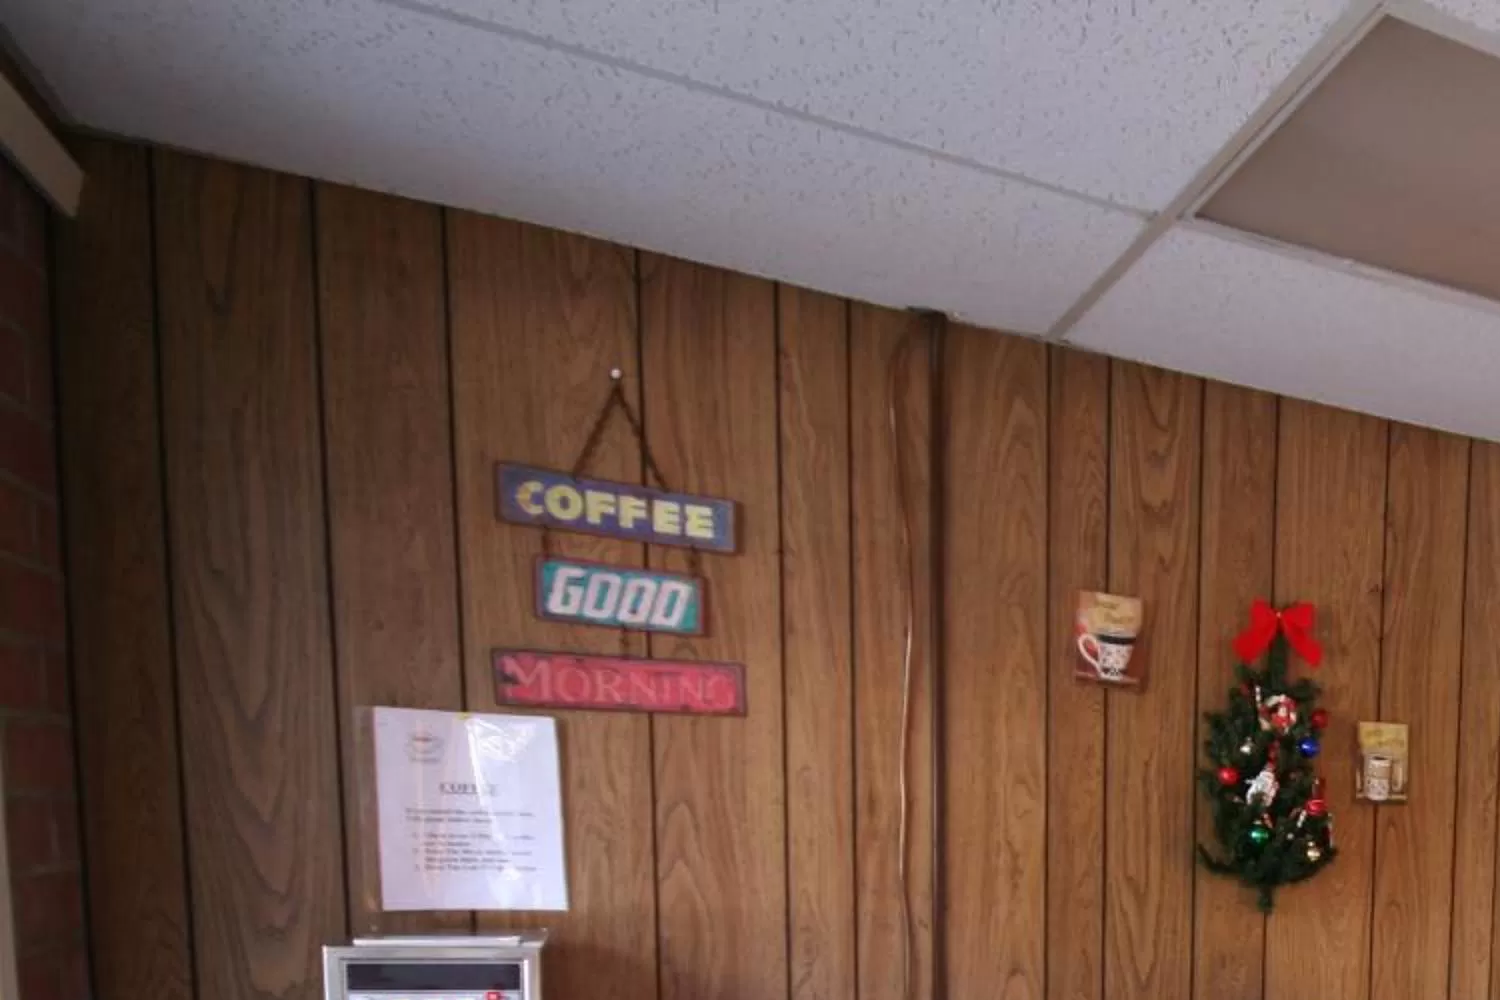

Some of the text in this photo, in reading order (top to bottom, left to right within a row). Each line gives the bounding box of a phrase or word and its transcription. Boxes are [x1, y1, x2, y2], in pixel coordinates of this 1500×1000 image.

[514, 480, 715, 539] COFFEE
[546, 566, 694, 628] GOOD
[501, 655, 736, 712] MORNING
